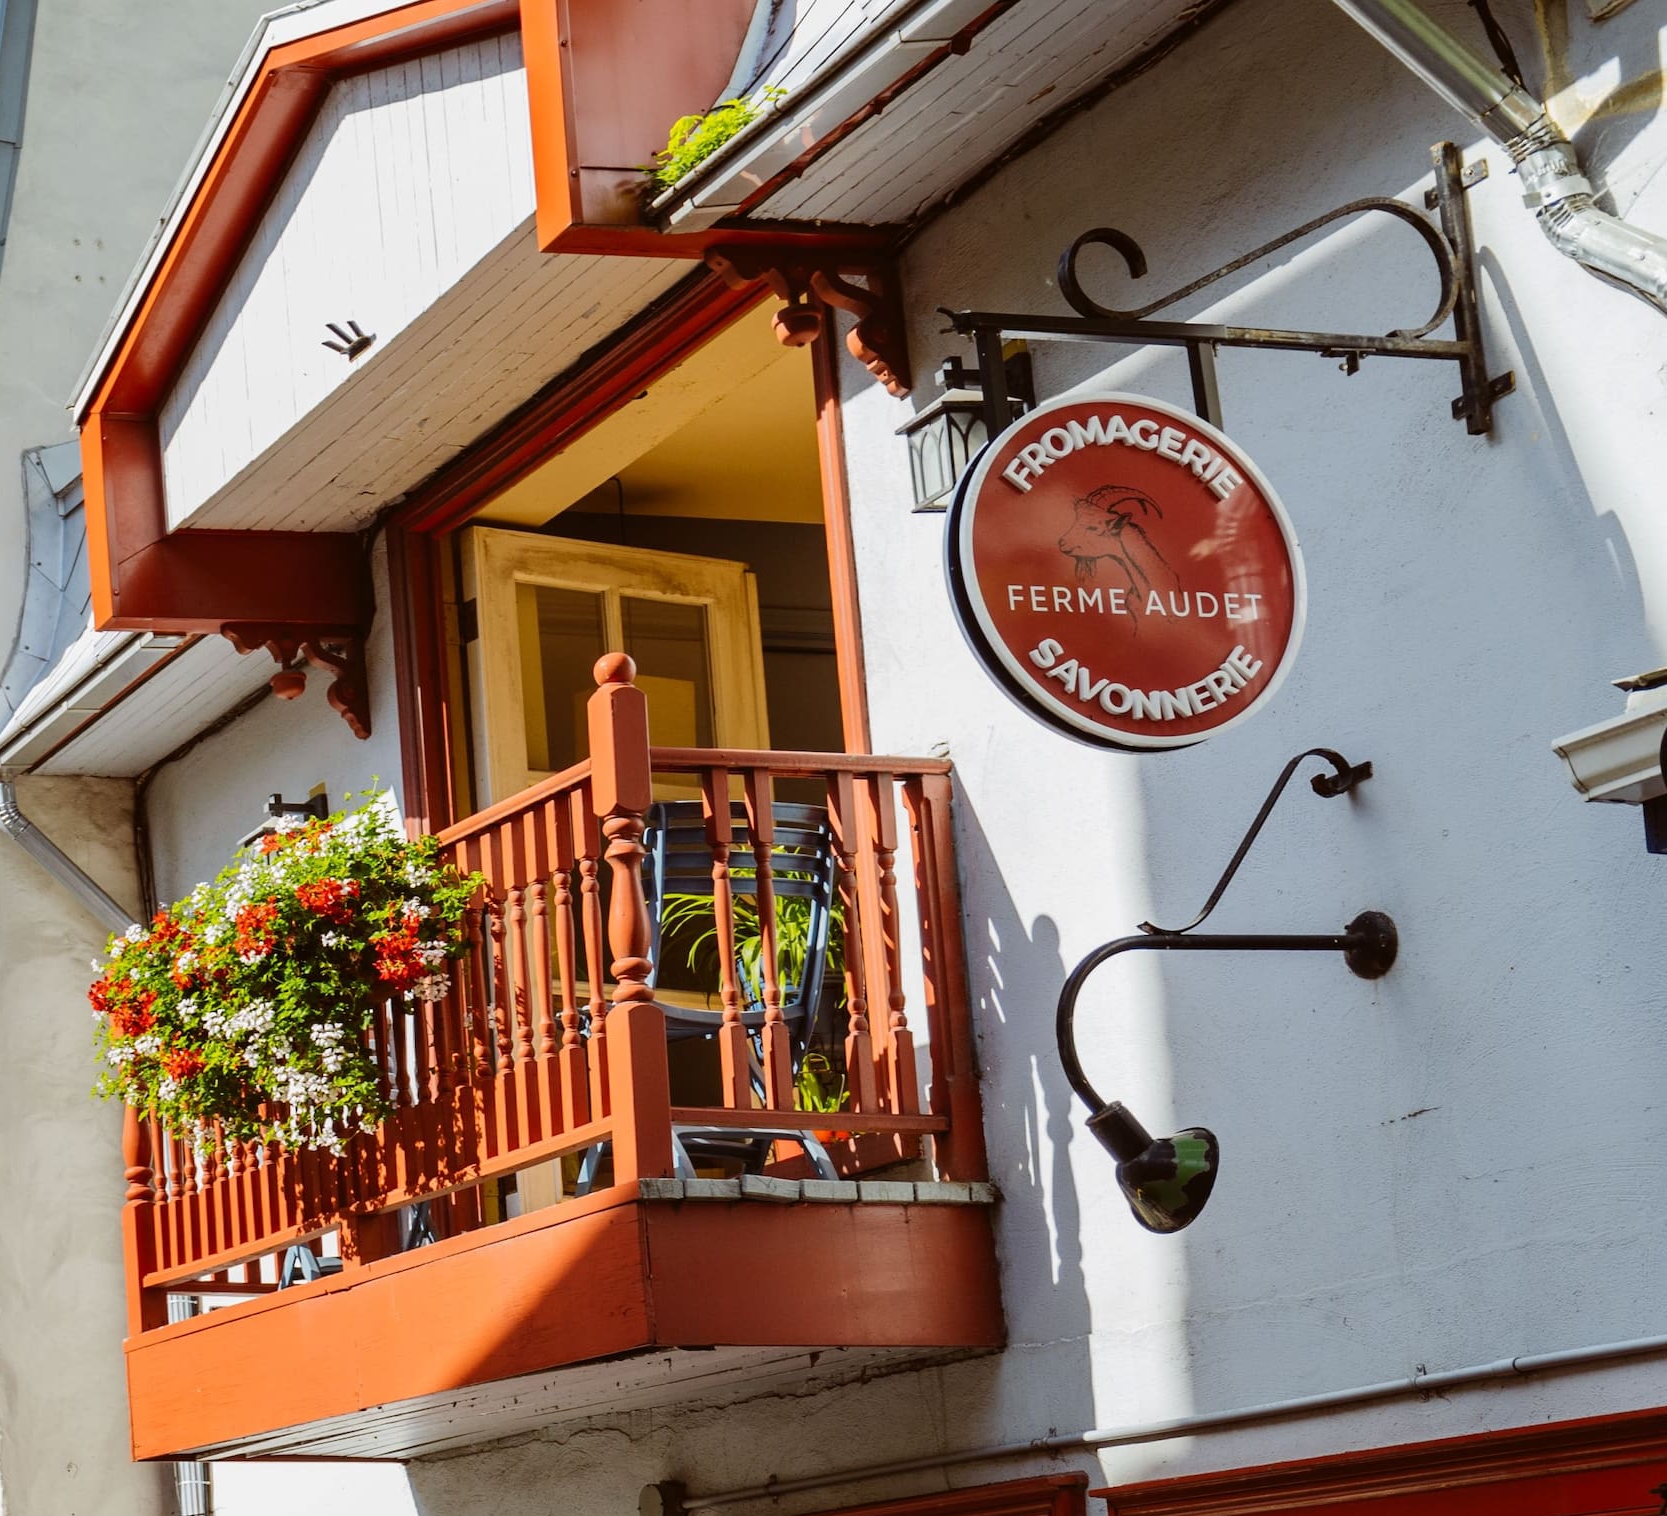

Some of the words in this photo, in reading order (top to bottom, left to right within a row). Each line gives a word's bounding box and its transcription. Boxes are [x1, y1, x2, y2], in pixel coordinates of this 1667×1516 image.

[1002, 414, 1244, 502] FROMAGERIE
[1007, 584, 1127, 615] FERME
[1145, 589, 1263, 621] AUDET
[1028, 637, 1264, 721] SAVONNERIE
